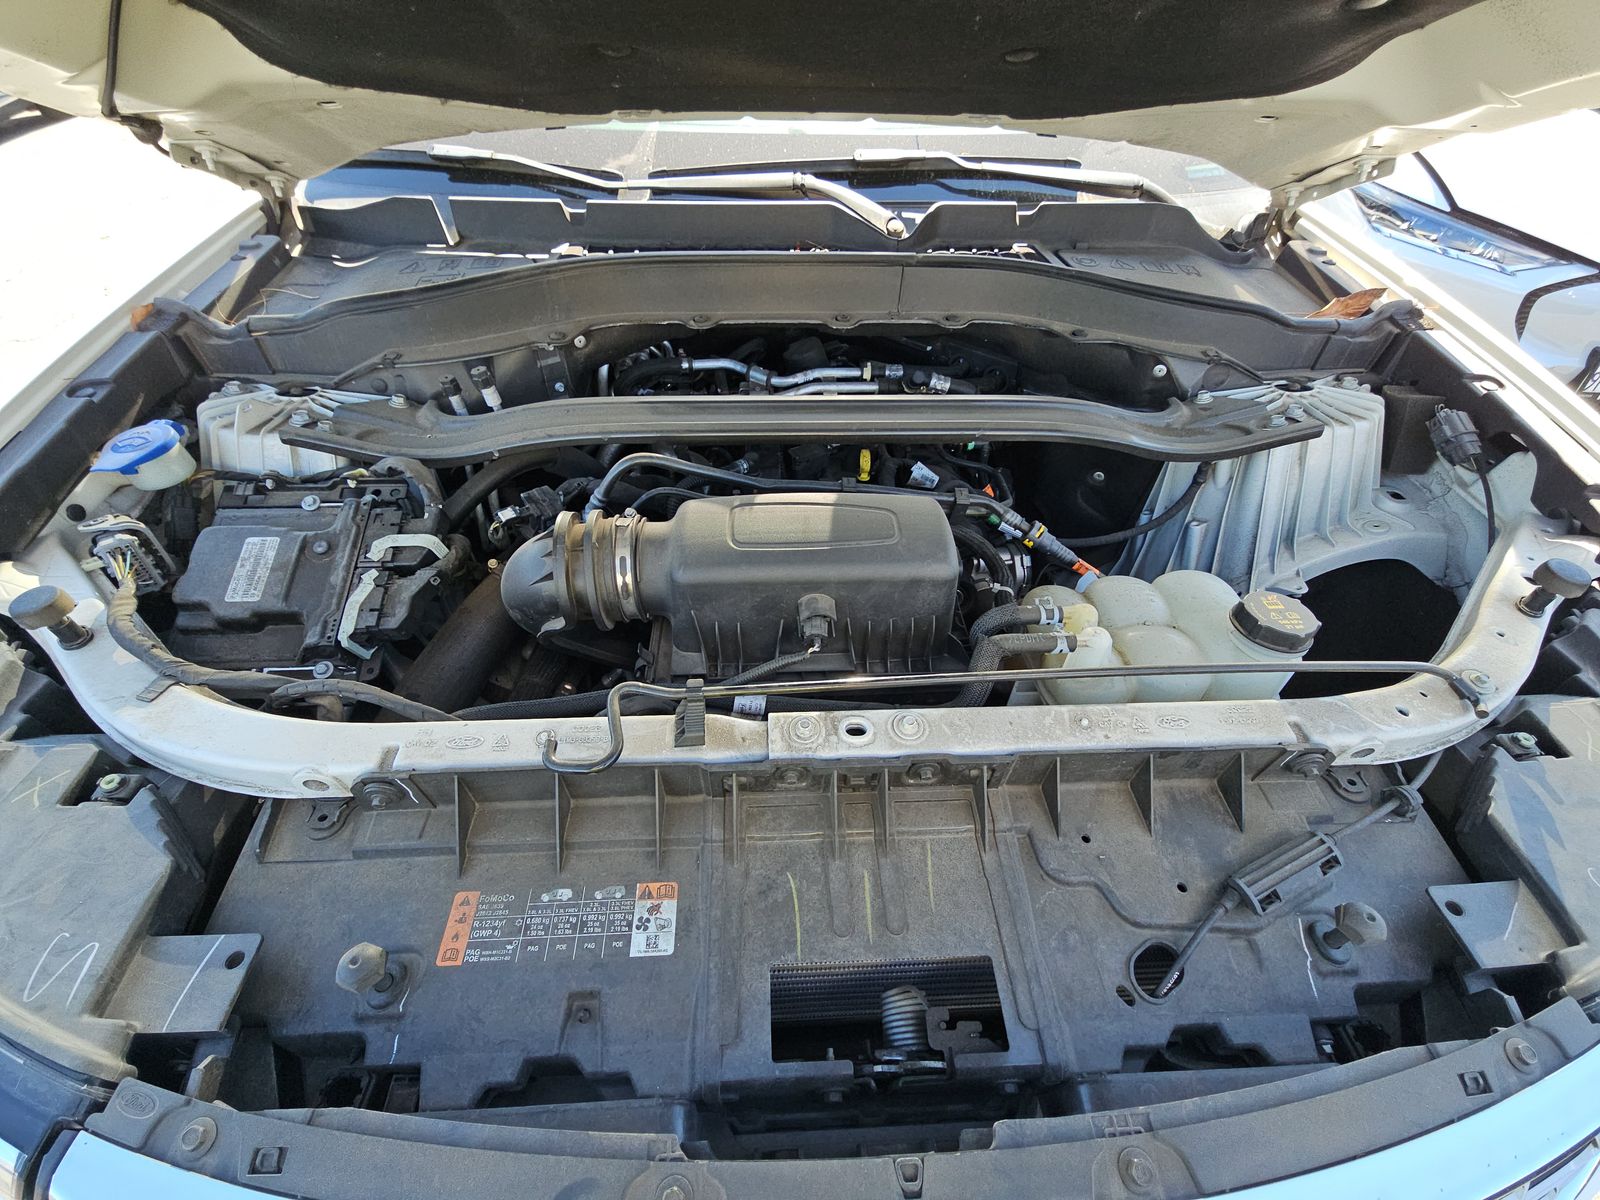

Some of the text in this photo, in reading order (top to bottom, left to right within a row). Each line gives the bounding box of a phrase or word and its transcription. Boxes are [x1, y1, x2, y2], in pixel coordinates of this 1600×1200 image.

[479, 893, 515, 903] FoMoCo
[542, 916, 550, 925] kg
[569, 915, 577, 923] kg
[598, 913, 606, 922] kg
[625, 913, 633, 921] kg
[473, 919, 507, 929] R-1234yf
[470, 930, 493, 939] (GWP
[463, 955, 480, 963] POE
